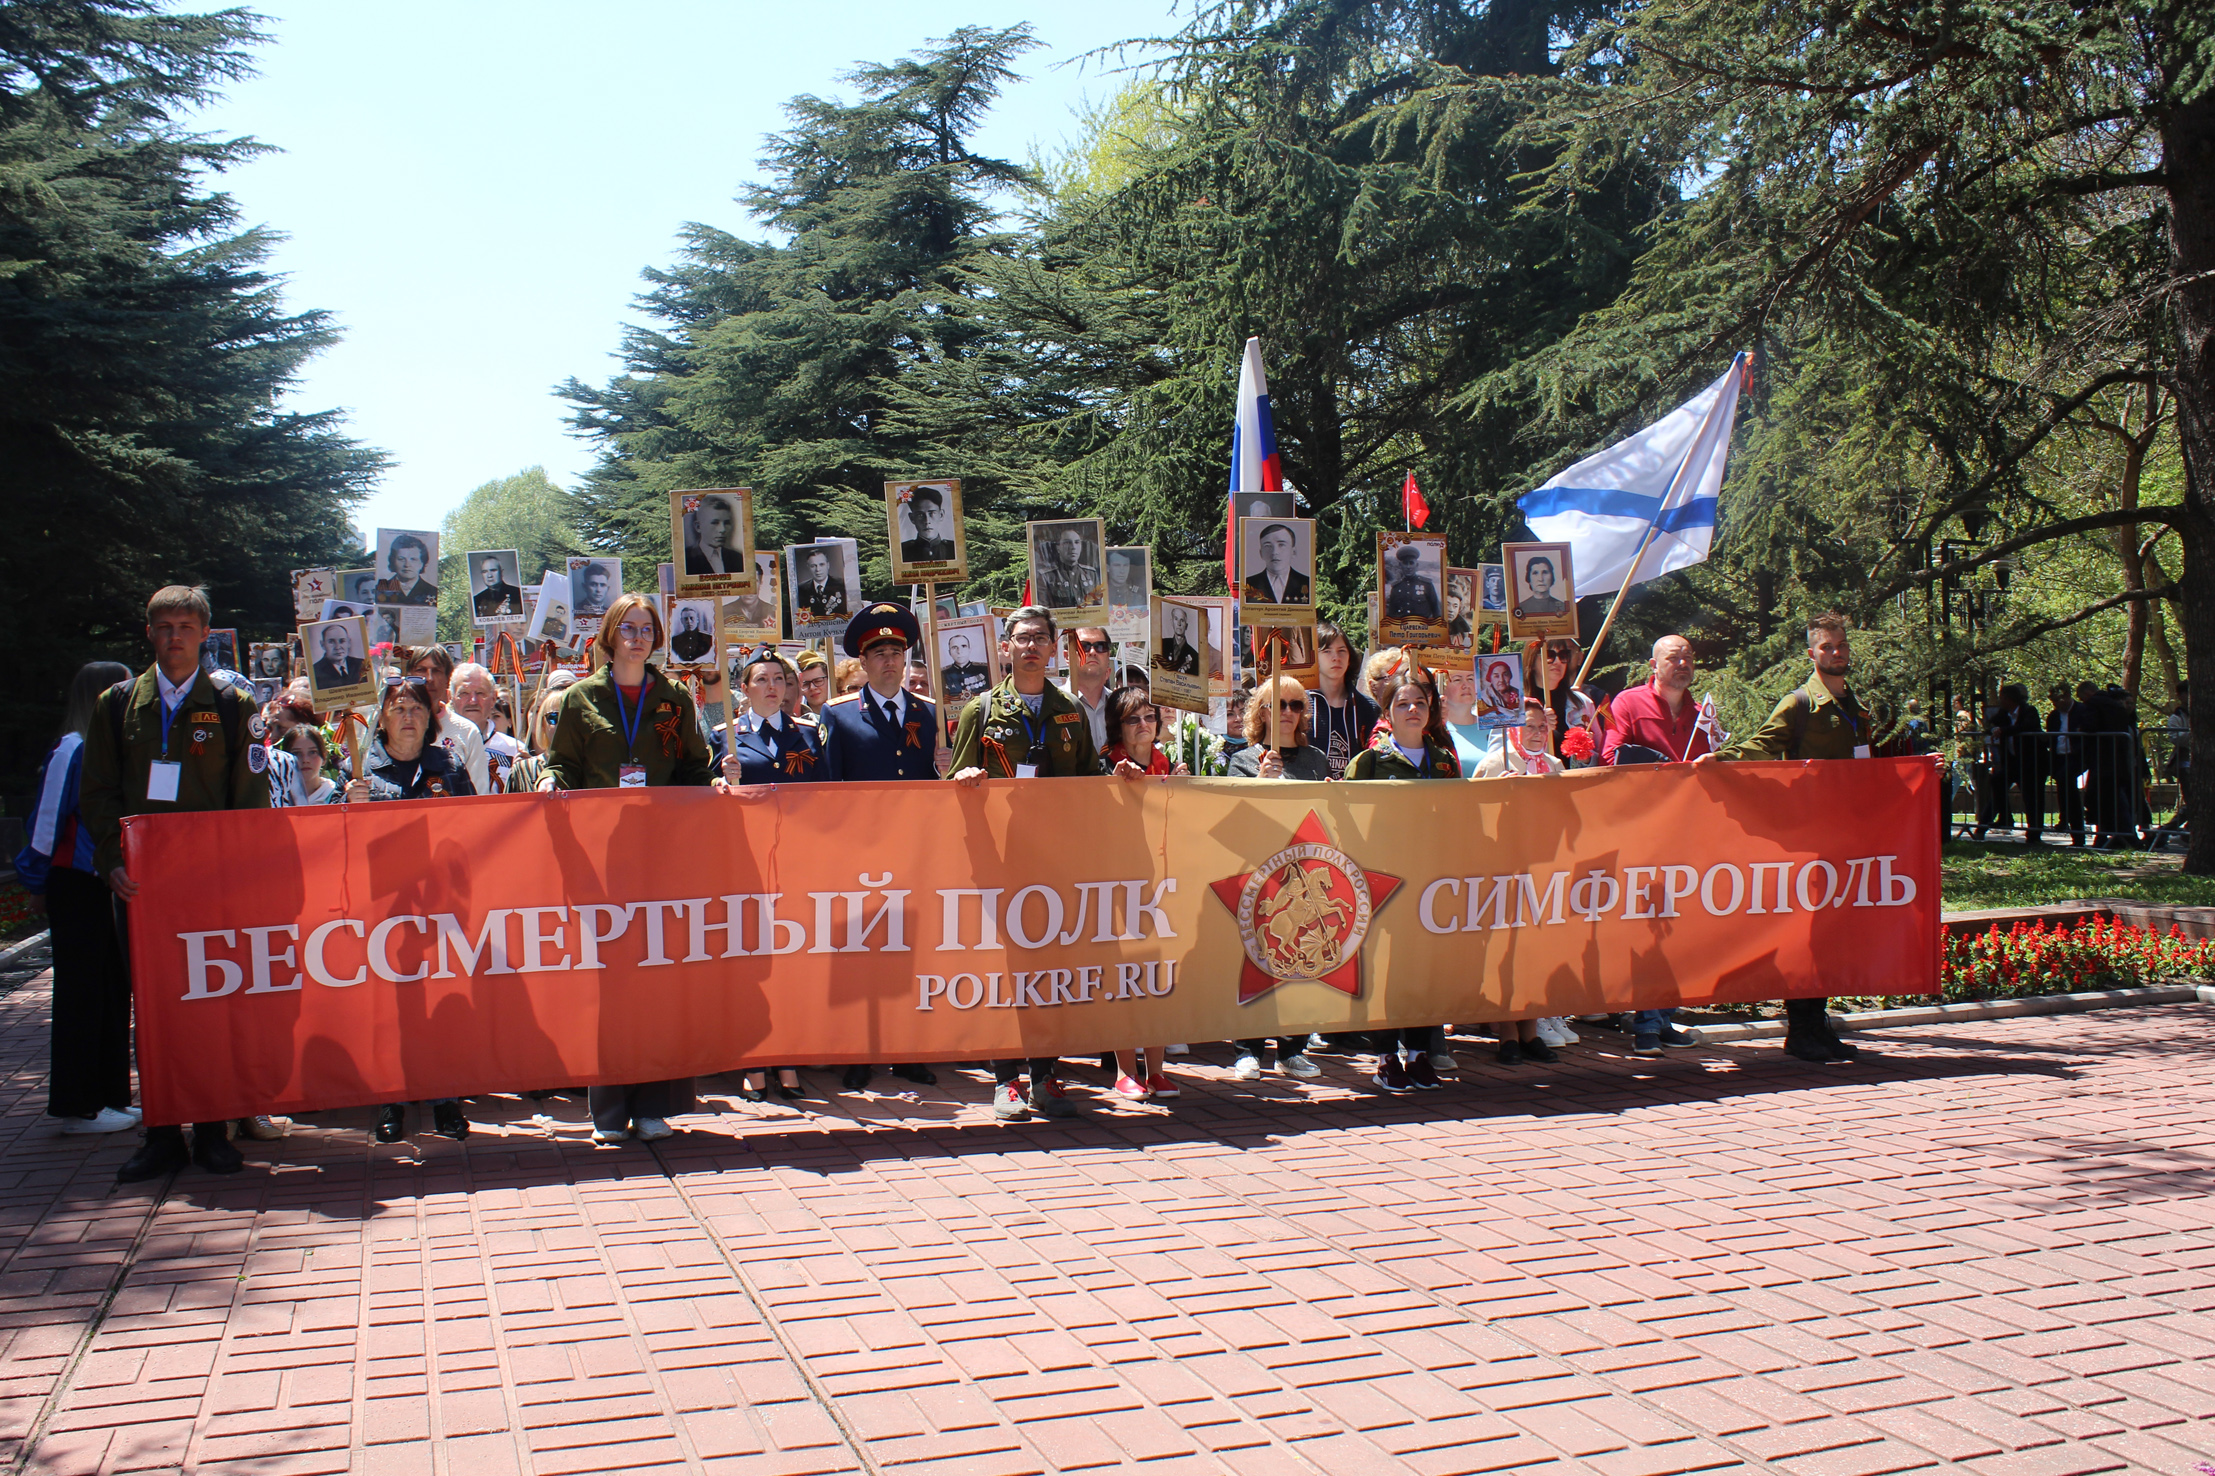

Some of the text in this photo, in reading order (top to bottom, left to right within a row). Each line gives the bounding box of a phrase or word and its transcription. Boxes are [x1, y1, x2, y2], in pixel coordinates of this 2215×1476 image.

[177, 872, 1177, 1001] БЕССМЕРТНЫЙ ПОЛК
[1239, 846, 1370, 941] БЕССМЕРТНЫЙ ПОЛК РОССИИ
[1419, 855, 1917, 934] СИМФЕРОПОЛЬ
[915, 960, 1177, 1011] POLKRF.RU
